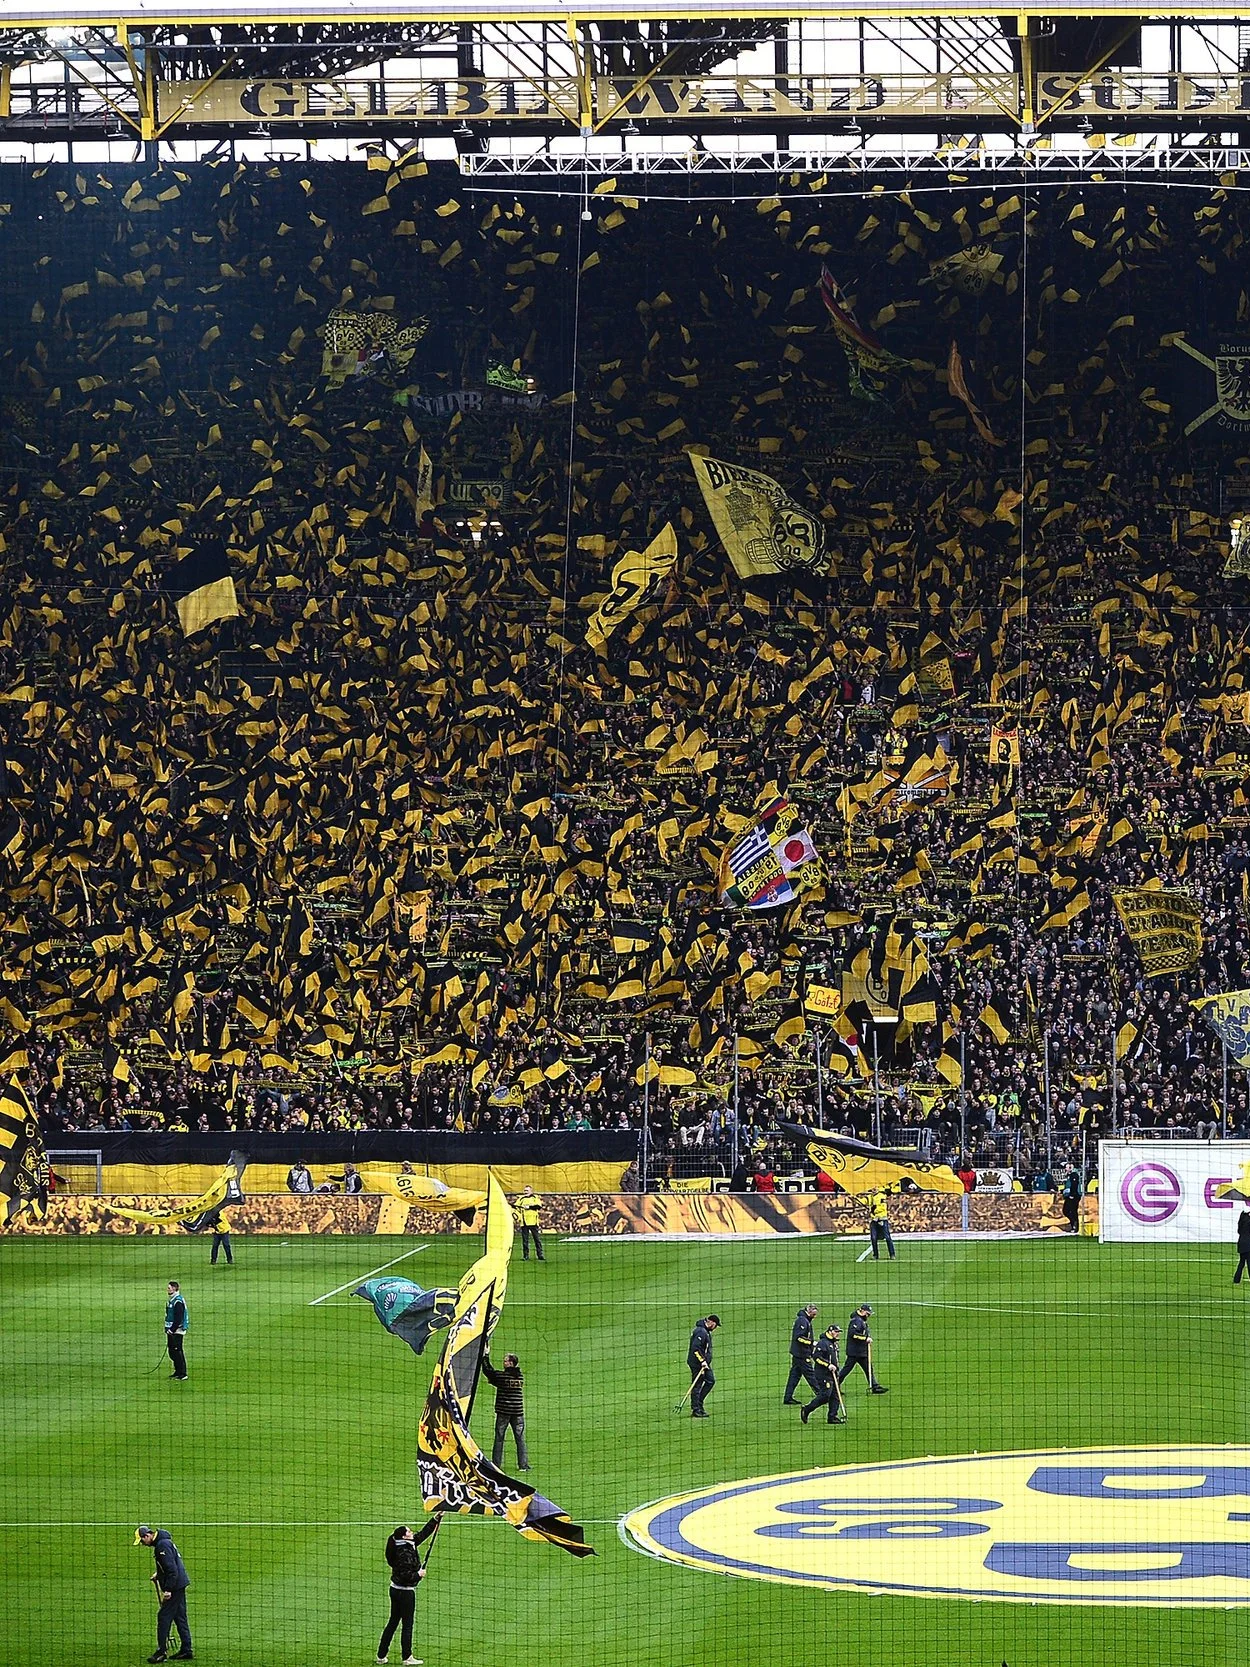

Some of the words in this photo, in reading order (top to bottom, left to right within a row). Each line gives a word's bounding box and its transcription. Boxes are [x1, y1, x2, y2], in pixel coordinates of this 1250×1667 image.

[240, 80, 552, 119] GELBE
[607, 79, 886, 115] WAND
[337, 329, 356, 343] BVB
